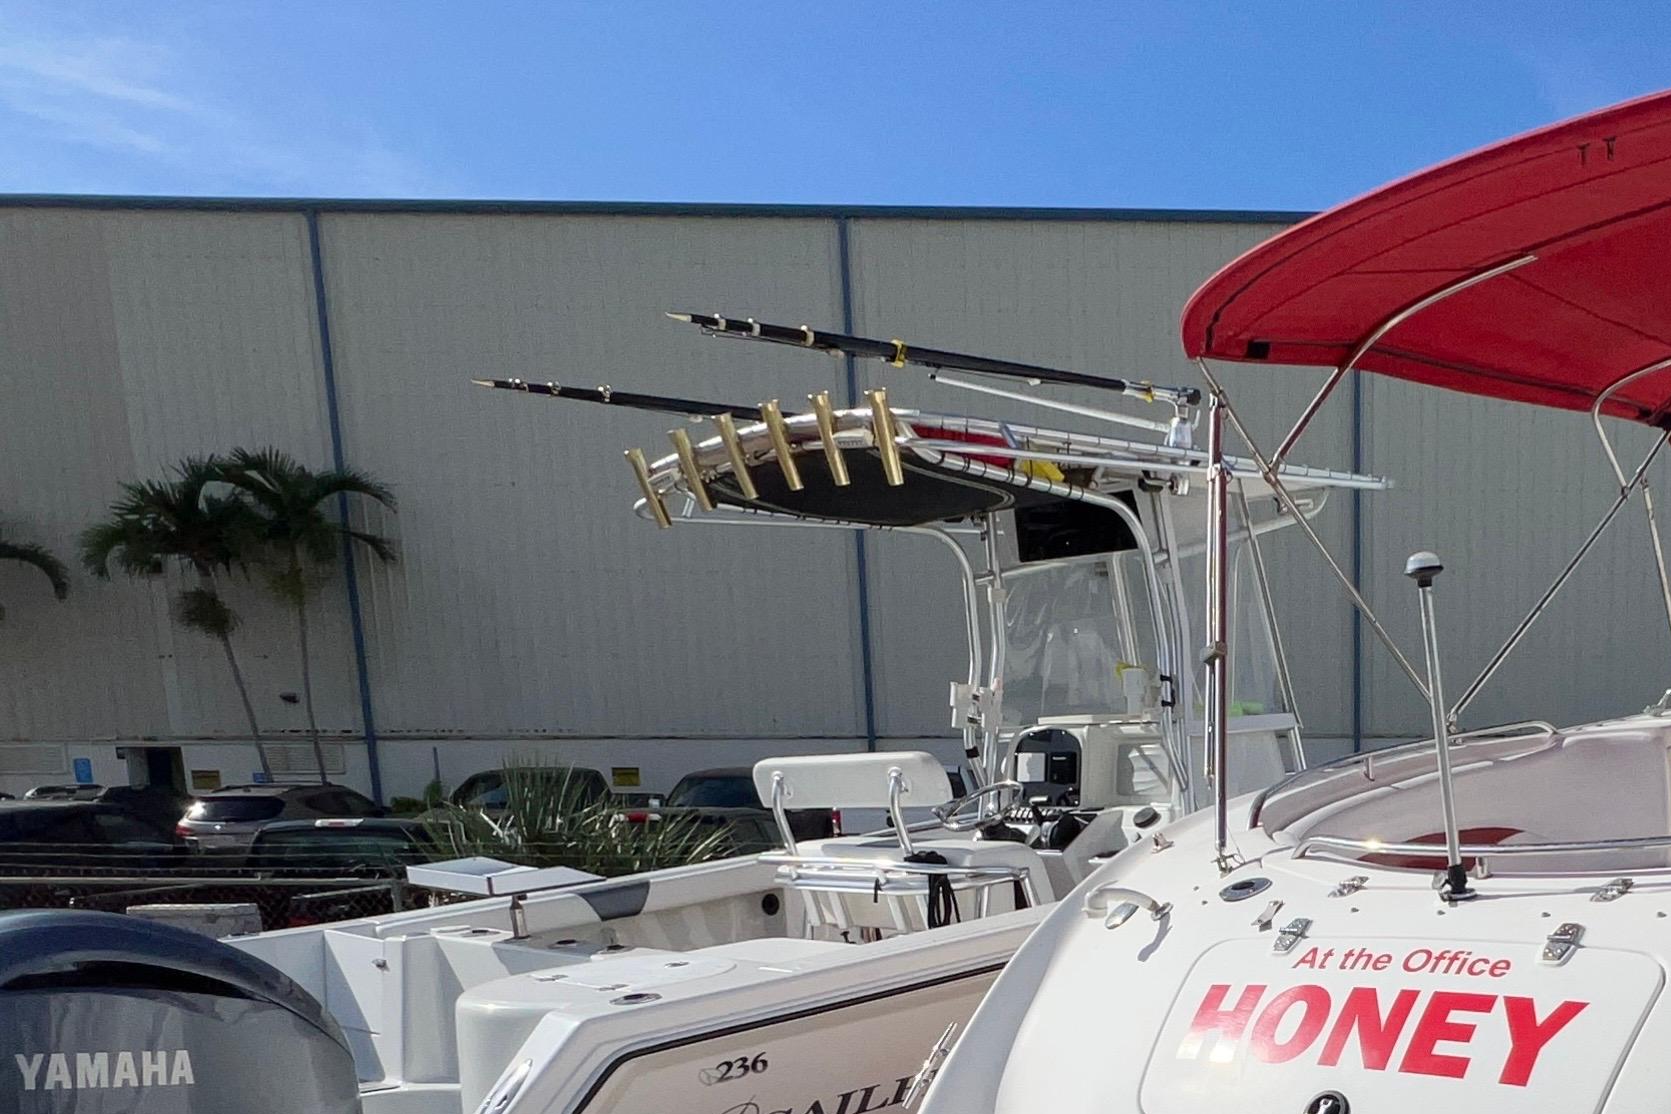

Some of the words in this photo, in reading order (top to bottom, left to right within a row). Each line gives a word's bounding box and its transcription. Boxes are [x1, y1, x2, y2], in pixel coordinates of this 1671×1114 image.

[1292, 946, 1336, 970] At
[1344, 947, 1393, 972] the
[1403, 947, 1512, 978] Office
[1176, 984, 1590, 1087] HONEY
[14, 1050, 195, 1091] YAMAHA
[715, 1052, 768, 1083] 236
